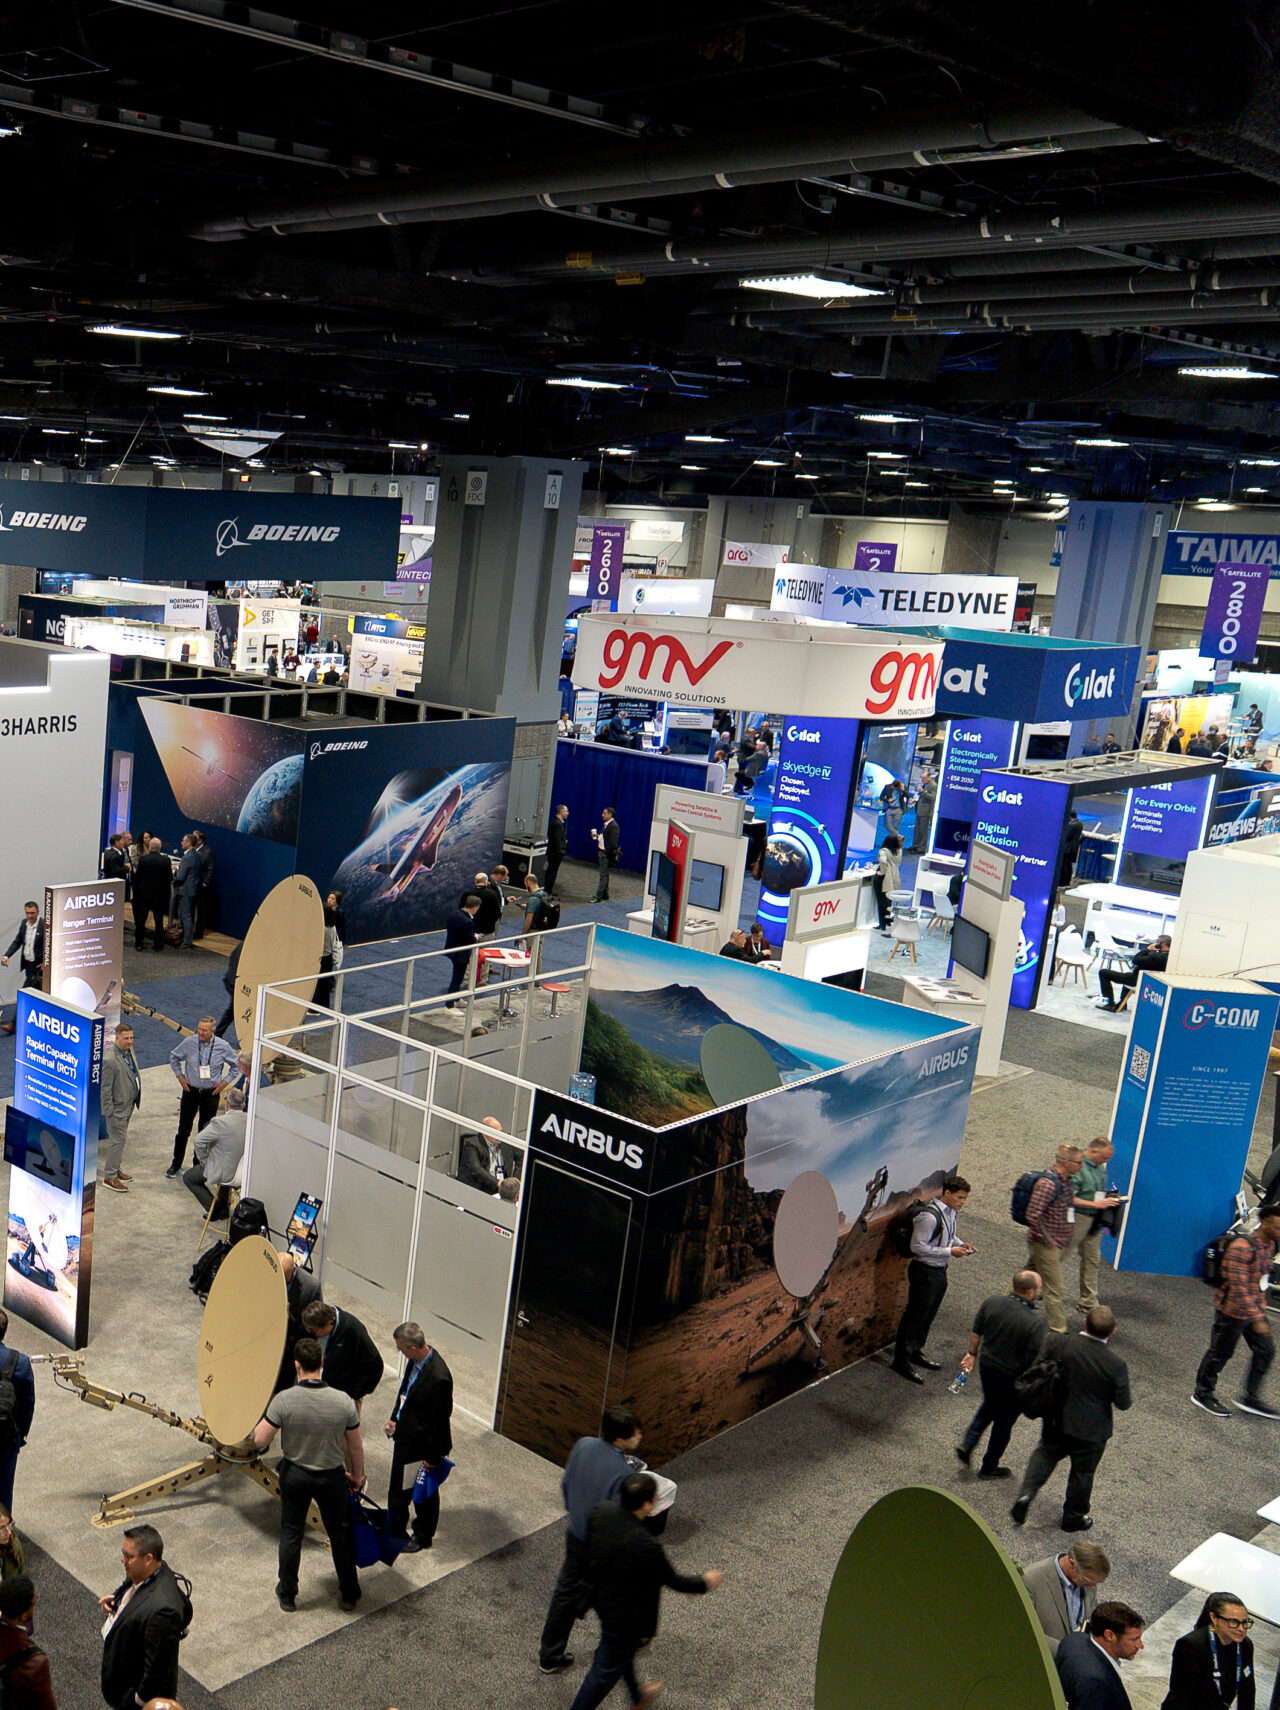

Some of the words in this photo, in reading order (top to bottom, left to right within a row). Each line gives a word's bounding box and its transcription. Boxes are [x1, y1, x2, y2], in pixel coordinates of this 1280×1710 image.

[550, 479, 557, 489] A
[548, 492, 558, 505] 10
[9, 510, 87, 532] BOEING
[246, 524, 340, 542] BOEING
[1177, 536, 1280, 565] TAIWA
[598, 539, 612, 596] 2600
[787, 578, 824, 604] TELEDYNE
[879, 588, 1009, 614] TELEDYNE
[1219, 581, 1247, 654] 2800
[599, 630, 734, 688] gmv
[624, 685, 672, 699] INNOVATING
[675, 692, 726, 704] SOLUTIONS
[1064, 662, 1115, 708] Gilat
[325, 740, 369, 752] BOEING
[951, 748, 998, 762] Electronically
[949, 756, 978, 766] Steered
[983, 786, 1023, 806] Gilat
[1135, 797, 1148, 806] For
[1150, 800, 1173, 811] Every
[1174, 803, 1197, 814] Orbit
[977, 821, 1009, 836] Digital
[976, 832, 1019, 848] Inclusion
[1020, 855, 1048, 867] Partner
[64, 892, 115, 911] AIRBUS
[813, 898, 841, 922] gmv
[63, 919, 86, 929] Ranger
[86, 915, 114, 925] Terminal
[27, 1009, 80, 1043] AIRBUS
[1191, 1005, 1260, 1028] C-COM
[26, 1036, 45, 1052] Rapid
[93, 1024, 102, 1060] AIRBUS
[26, 1048, 55, 1069] Terminal
[57, 1062, 77, 1080] (RCT)
[919, 1045, 970, 1079] AIRBUS
[91, 1064, 100, 1084] RCT
[539, 1113, 645, 1171] AIRBUS
